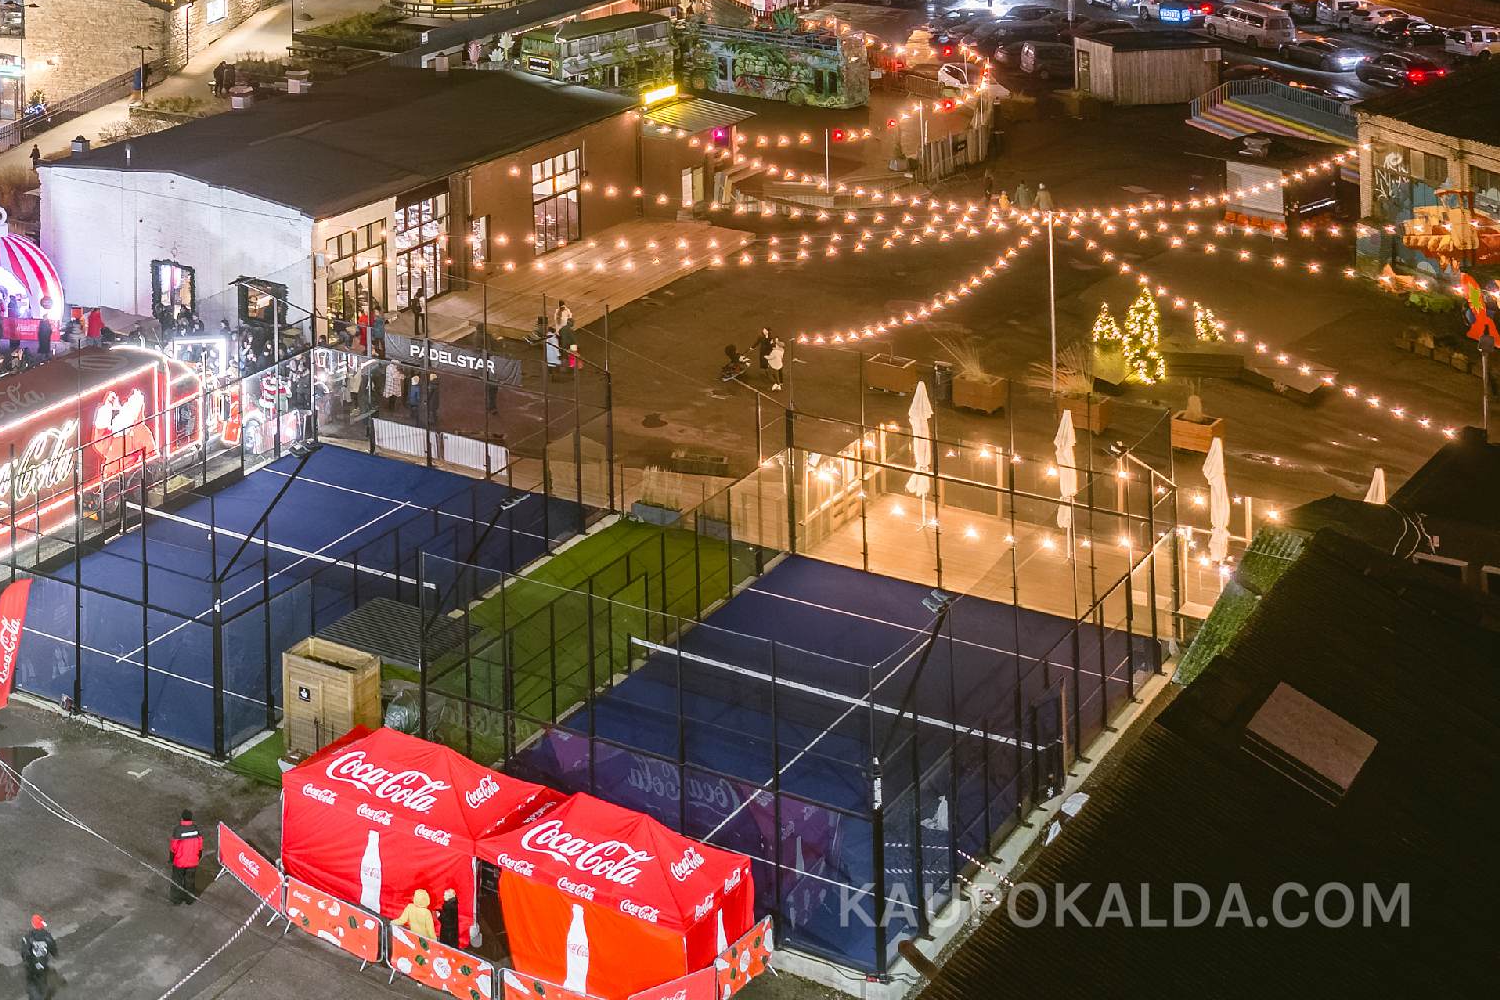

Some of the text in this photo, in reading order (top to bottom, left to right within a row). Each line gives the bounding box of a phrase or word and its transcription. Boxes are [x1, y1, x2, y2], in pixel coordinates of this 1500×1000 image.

[409, 344, 495, 375] PADELSTAR
[302, 783, 337, 806] Coca-Cola
[325, 751, 451, 814] Coca-Cola
[465, 773, 500, 809] Coca-Cola
[356, 803, 392, 827] Coca-Cola
[414, 823, 451, 848] Coca-Cola
[238, 852, 261, 877] Coca-Cola
[497, 853, 536, 877] Coca-Cola
[521, 819, 655, 886] Coca-Cola
[670, 846, 705, 882] Coca-Cola
[557, 876, 597, 901] Coca-Cola
[619, 899, 659, 923] Coca-Cola
